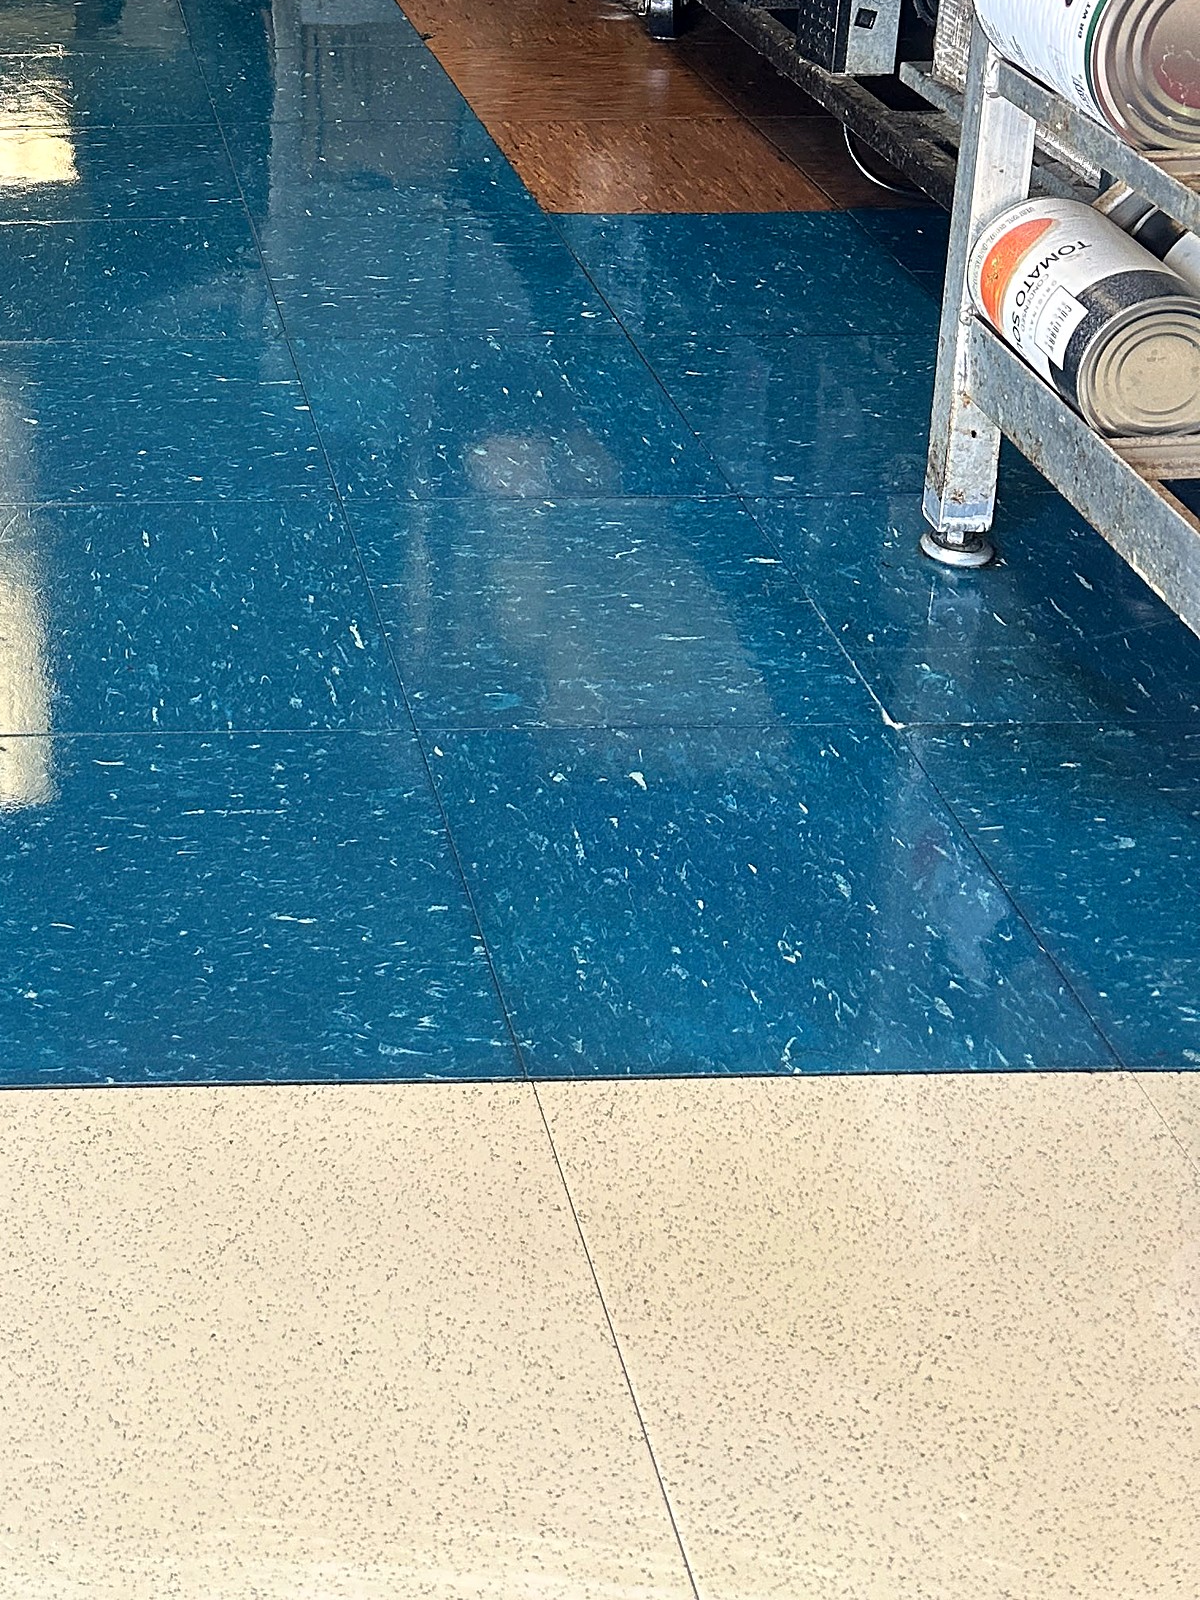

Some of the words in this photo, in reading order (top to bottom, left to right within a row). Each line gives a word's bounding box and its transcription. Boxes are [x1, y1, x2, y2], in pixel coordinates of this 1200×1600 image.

[1081, 2, 1092, 21] WT
[1016, 241, 1092, 307] TOMATO
[1021, 273, 1049, 332] CONDENSED
